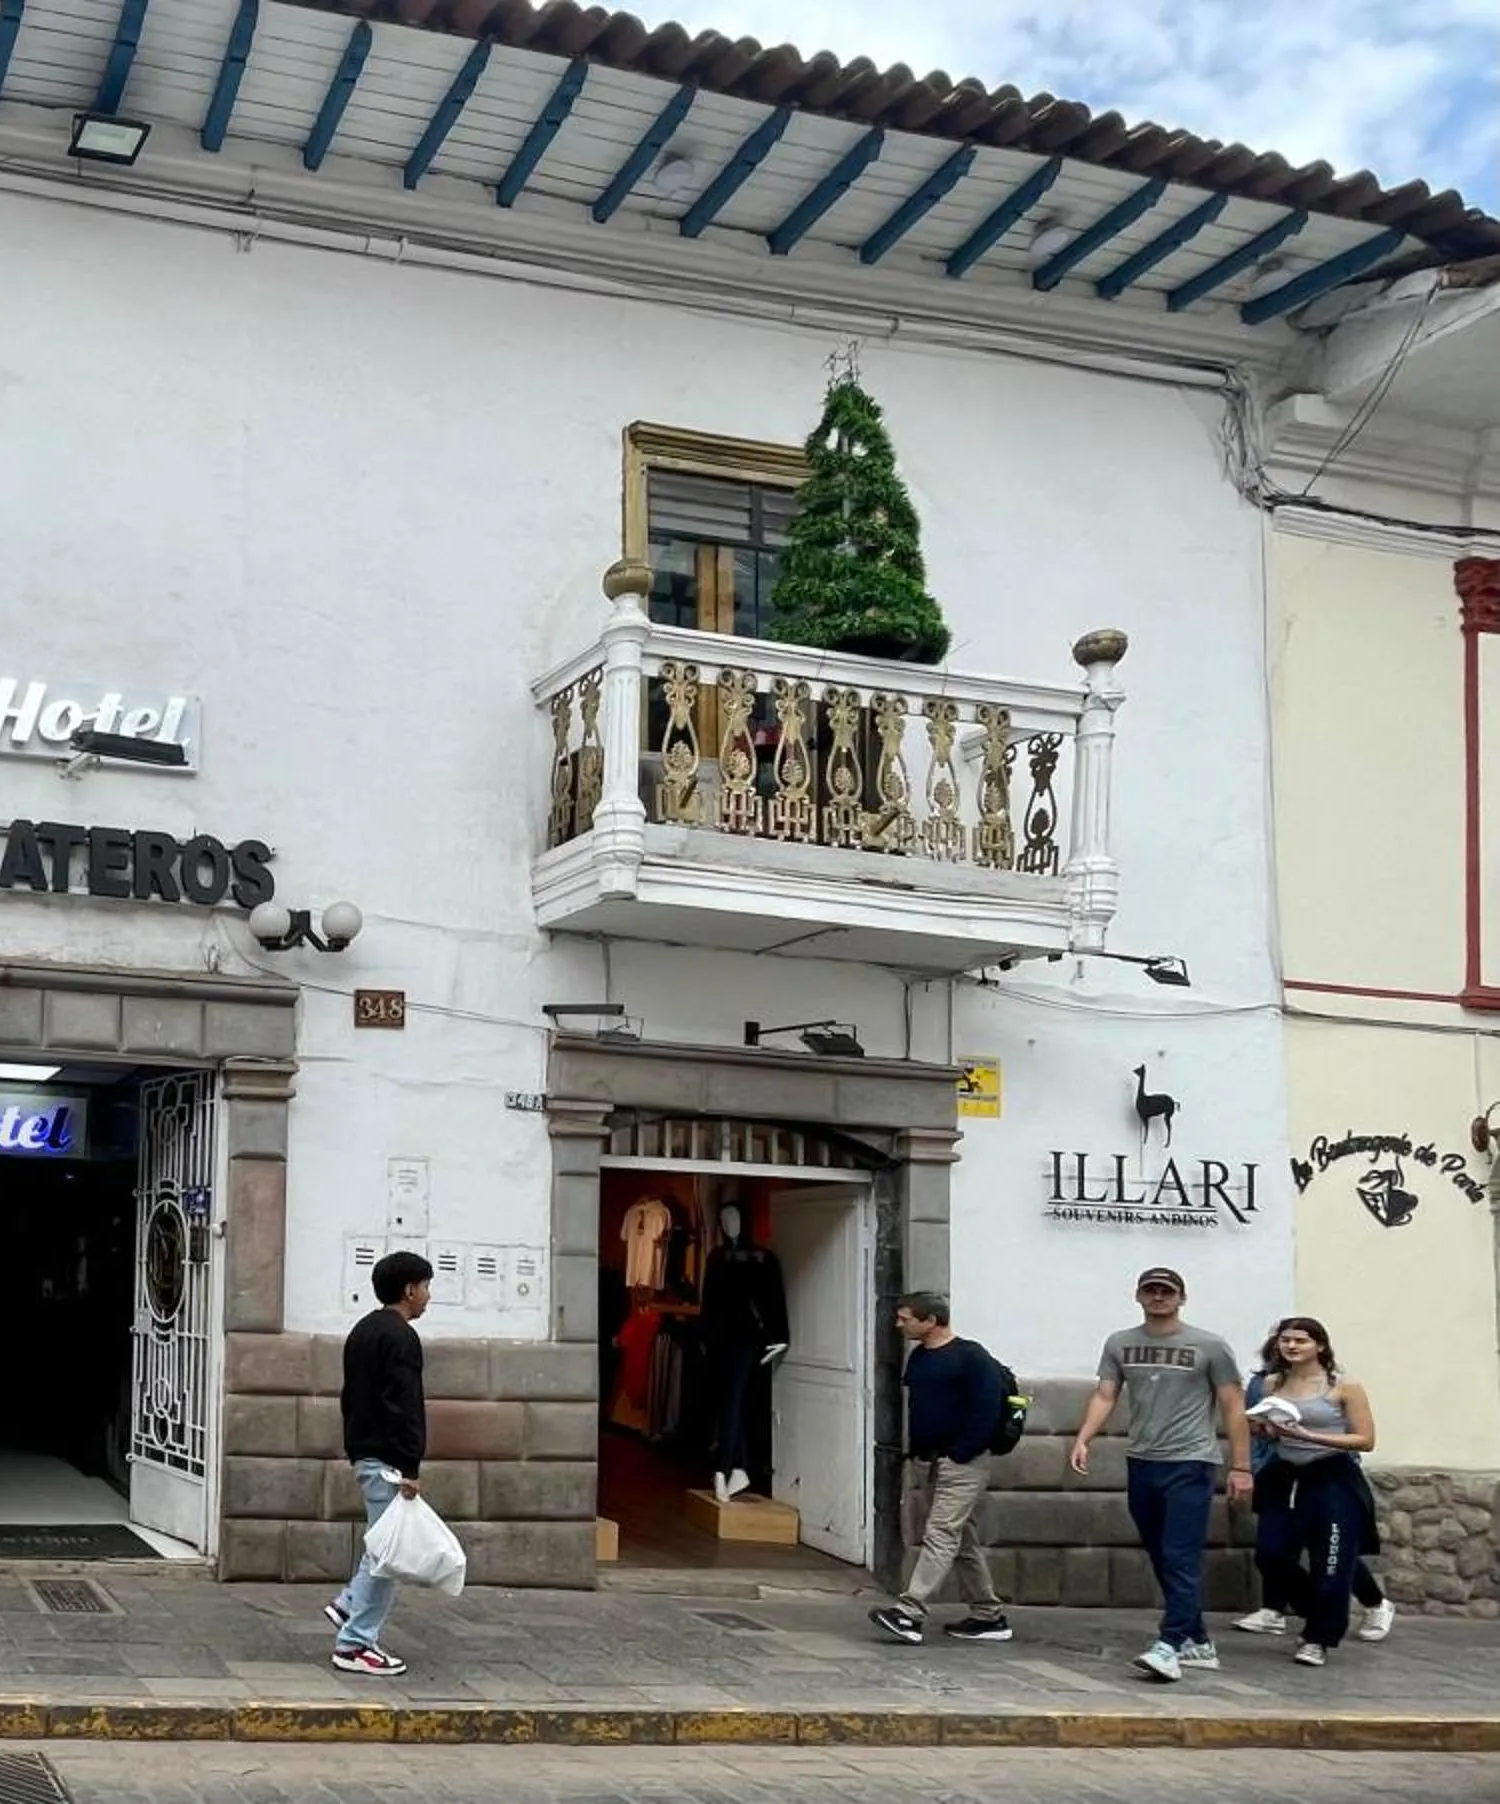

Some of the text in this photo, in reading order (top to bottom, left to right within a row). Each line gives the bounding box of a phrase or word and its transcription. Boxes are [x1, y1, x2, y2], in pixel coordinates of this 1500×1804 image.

[359, 996, 403, 1020] 348
[1049, 1150, 1262, 1224] ILLARI
[1050, 1206, 1219, 1228] SOUVENIRS ANDINOS
[1122, 1346, 1196, 1366] TUFTS
